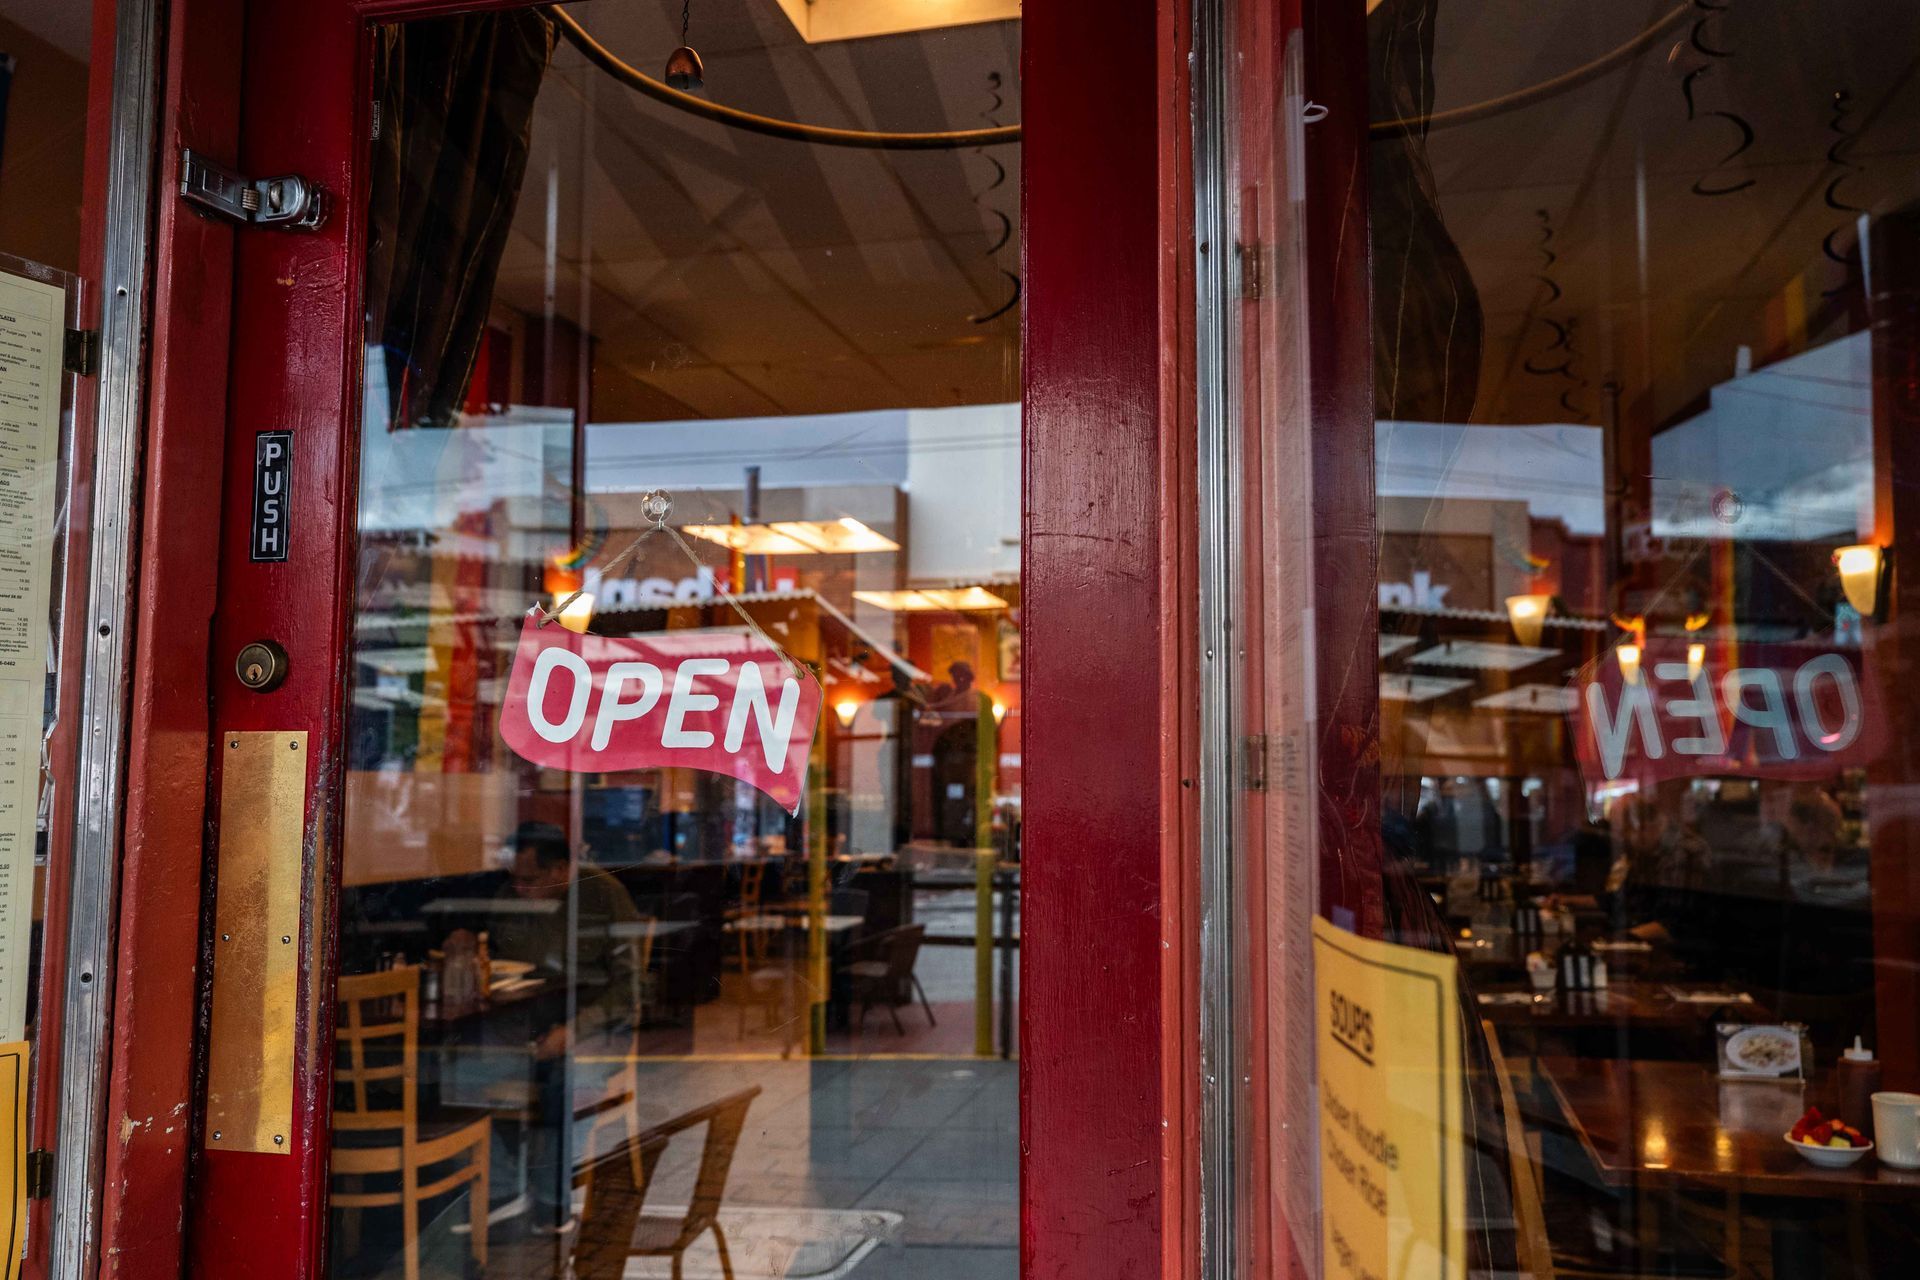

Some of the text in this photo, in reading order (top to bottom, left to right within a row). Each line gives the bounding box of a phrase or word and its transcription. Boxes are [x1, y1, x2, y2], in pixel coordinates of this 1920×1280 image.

[261, 442, 283, 552] PUSH
[526, 646, 801, 775] OPEN
[1329, 989, 1375, 1054] SOUPS
